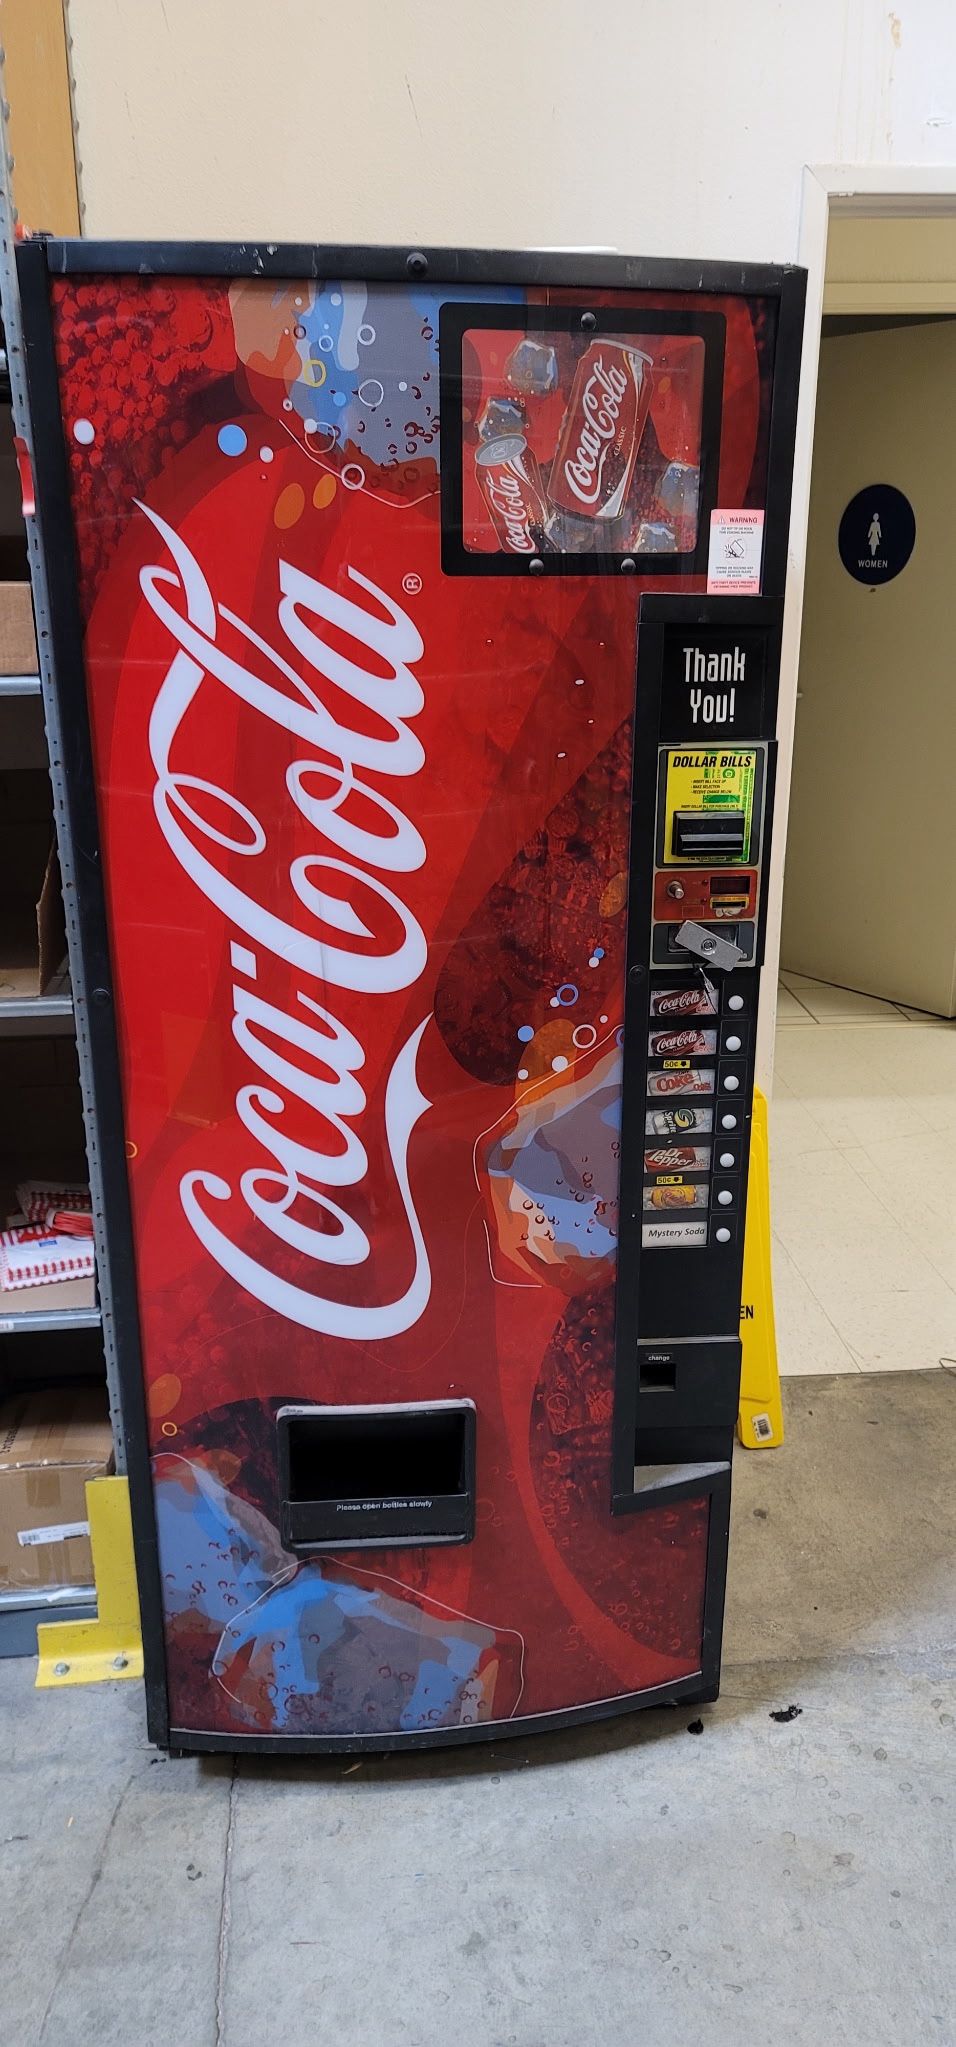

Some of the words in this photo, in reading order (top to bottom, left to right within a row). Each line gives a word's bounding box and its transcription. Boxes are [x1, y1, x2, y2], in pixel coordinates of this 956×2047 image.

[565, 354, 628, 504] Coca-Cola
[613, 426, 627, 456] CLASSIC
[729, 516, 758, 524] WARNING
[858, 559, 888, 568] WOMEN
[683, 646, 746, 683] Thank
[690, 687, 736, 724] You!
[672, 755, 717, 768] DOLLAR
[720, 755, 752, 768] BILLS
[131, 497, 434, 1341] Coca-Cola
[658, 990, 701, 1014] Coca-Cola
[656, 1030, 698, 1053] Coca-Cola
[664, 1060, 679, 1068] 50¢
[656, 1073, 694, 1092] Coke
[664, 1111, 677, 1133] Sprite
[649, 1149, 693, 1166] Pepper
[665, 1147, 683, 1158] Dr
[648, 1229, 683, 1238] Mystery
[684, 1227, 705, 1236] Soda
[336, 1503, 361, 1511] Please
[362, 1503, 381, 1511] open
[382, 1501, 408, 1509] bottles
[409, 1500, 433, 1509] slowly
